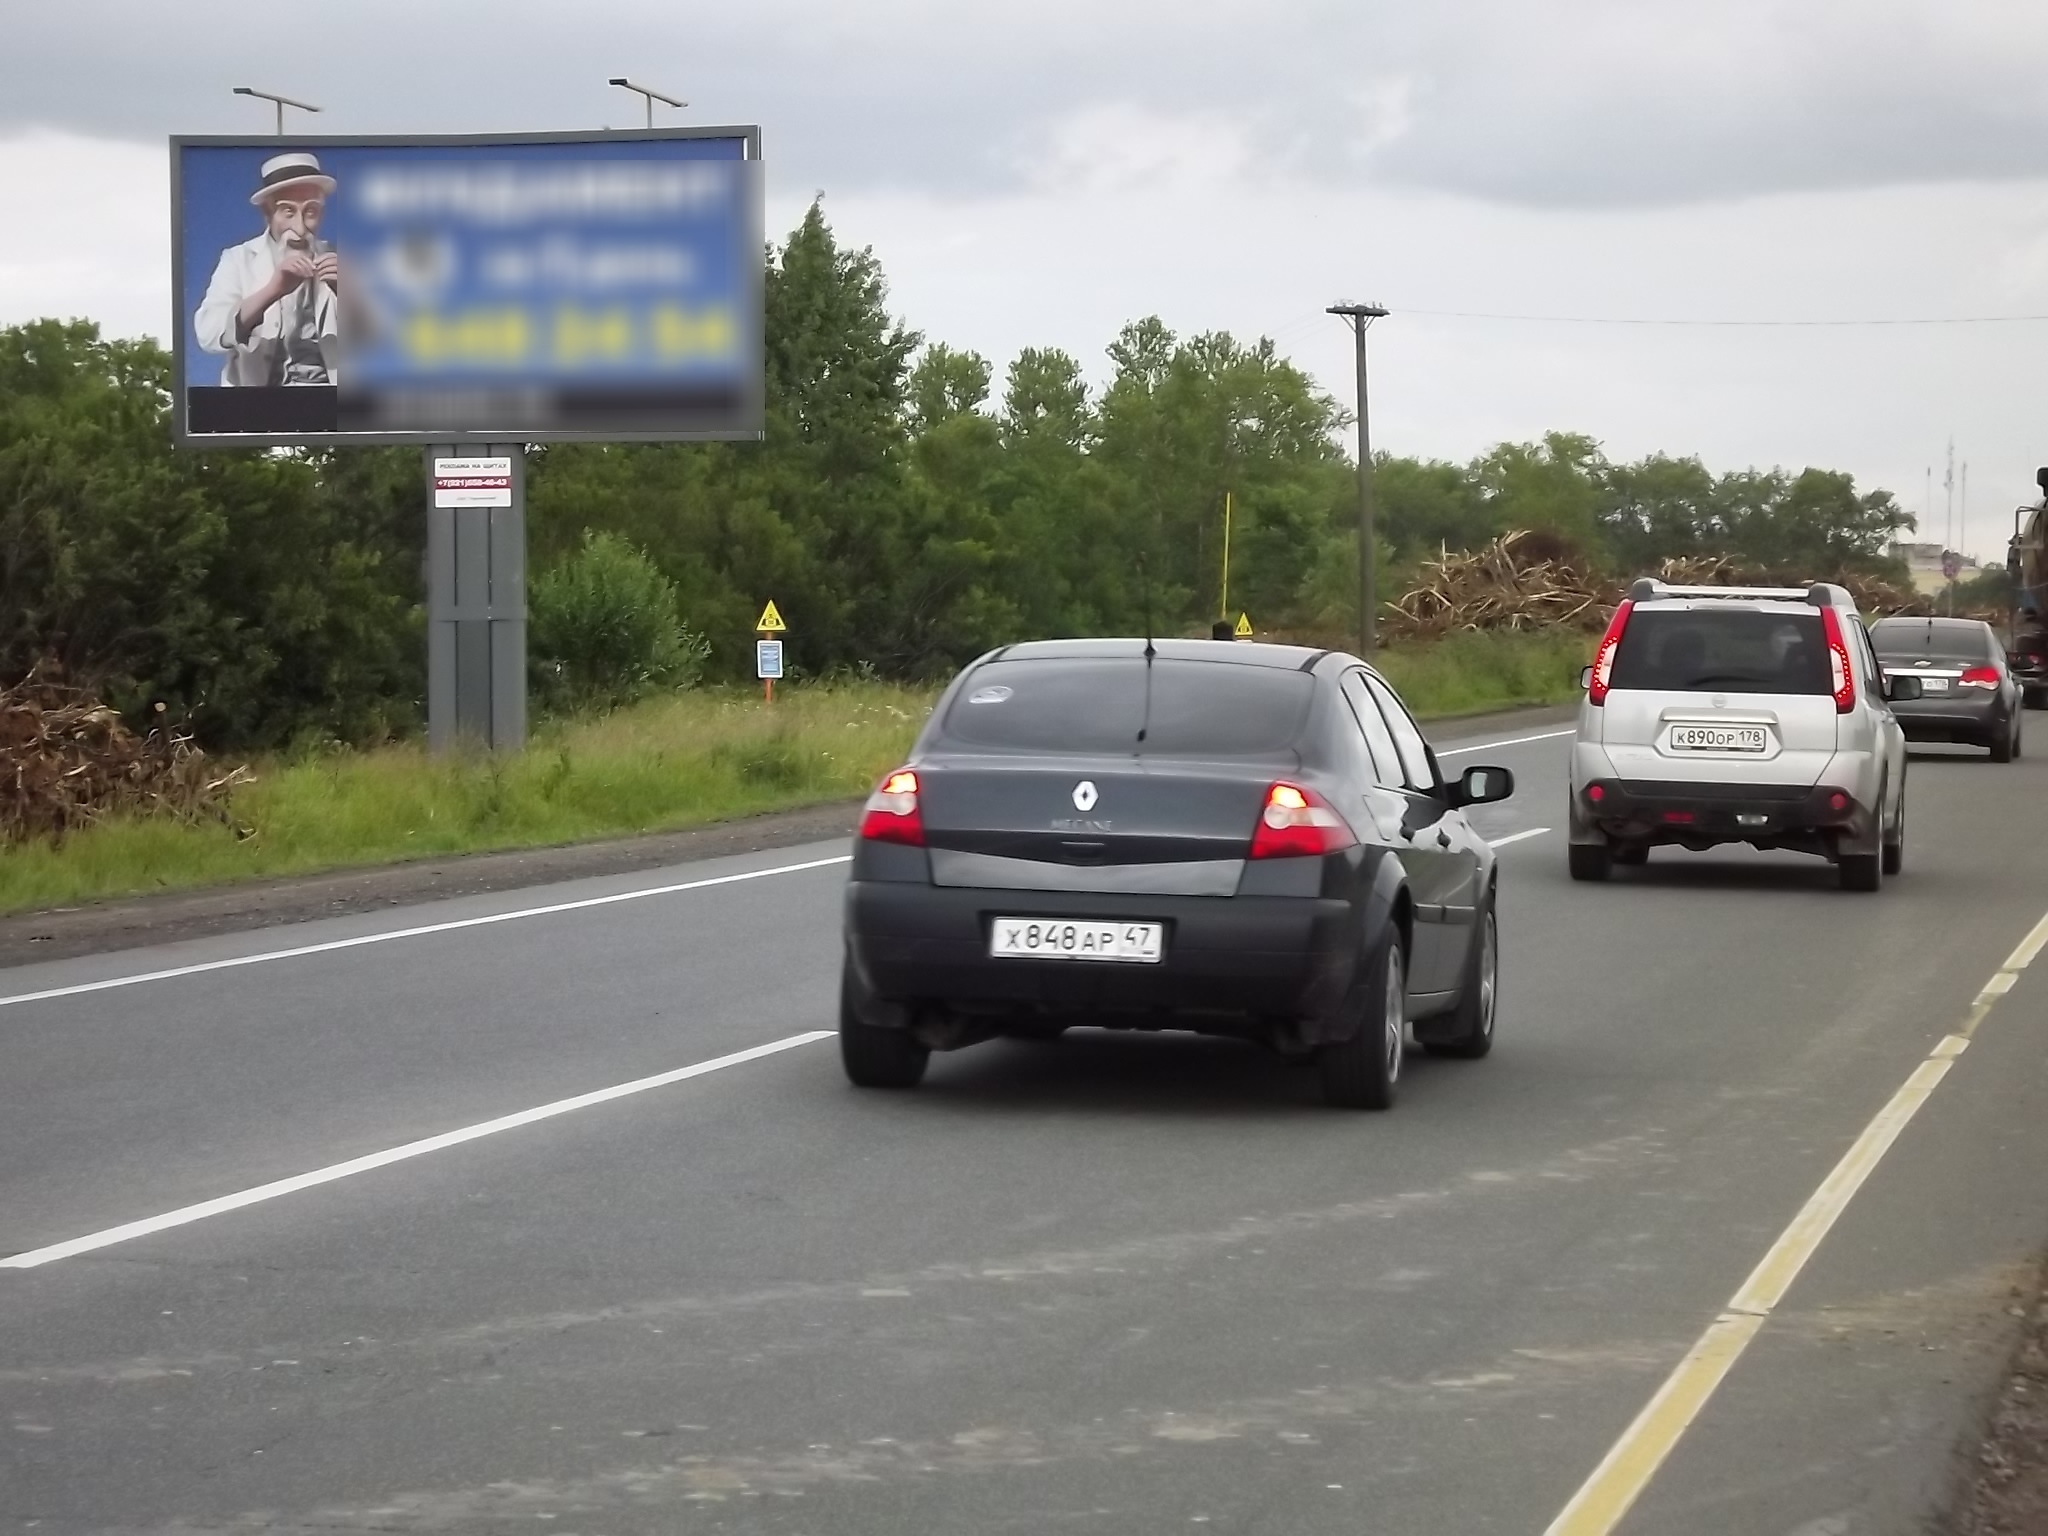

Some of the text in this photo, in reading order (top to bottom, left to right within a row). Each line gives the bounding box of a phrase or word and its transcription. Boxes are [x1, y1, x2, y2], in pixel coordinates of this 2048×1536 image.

[1677, 729, 1761, 745] К890ОР 178
[1005, 923, 1151, 952] Х848АР 47
